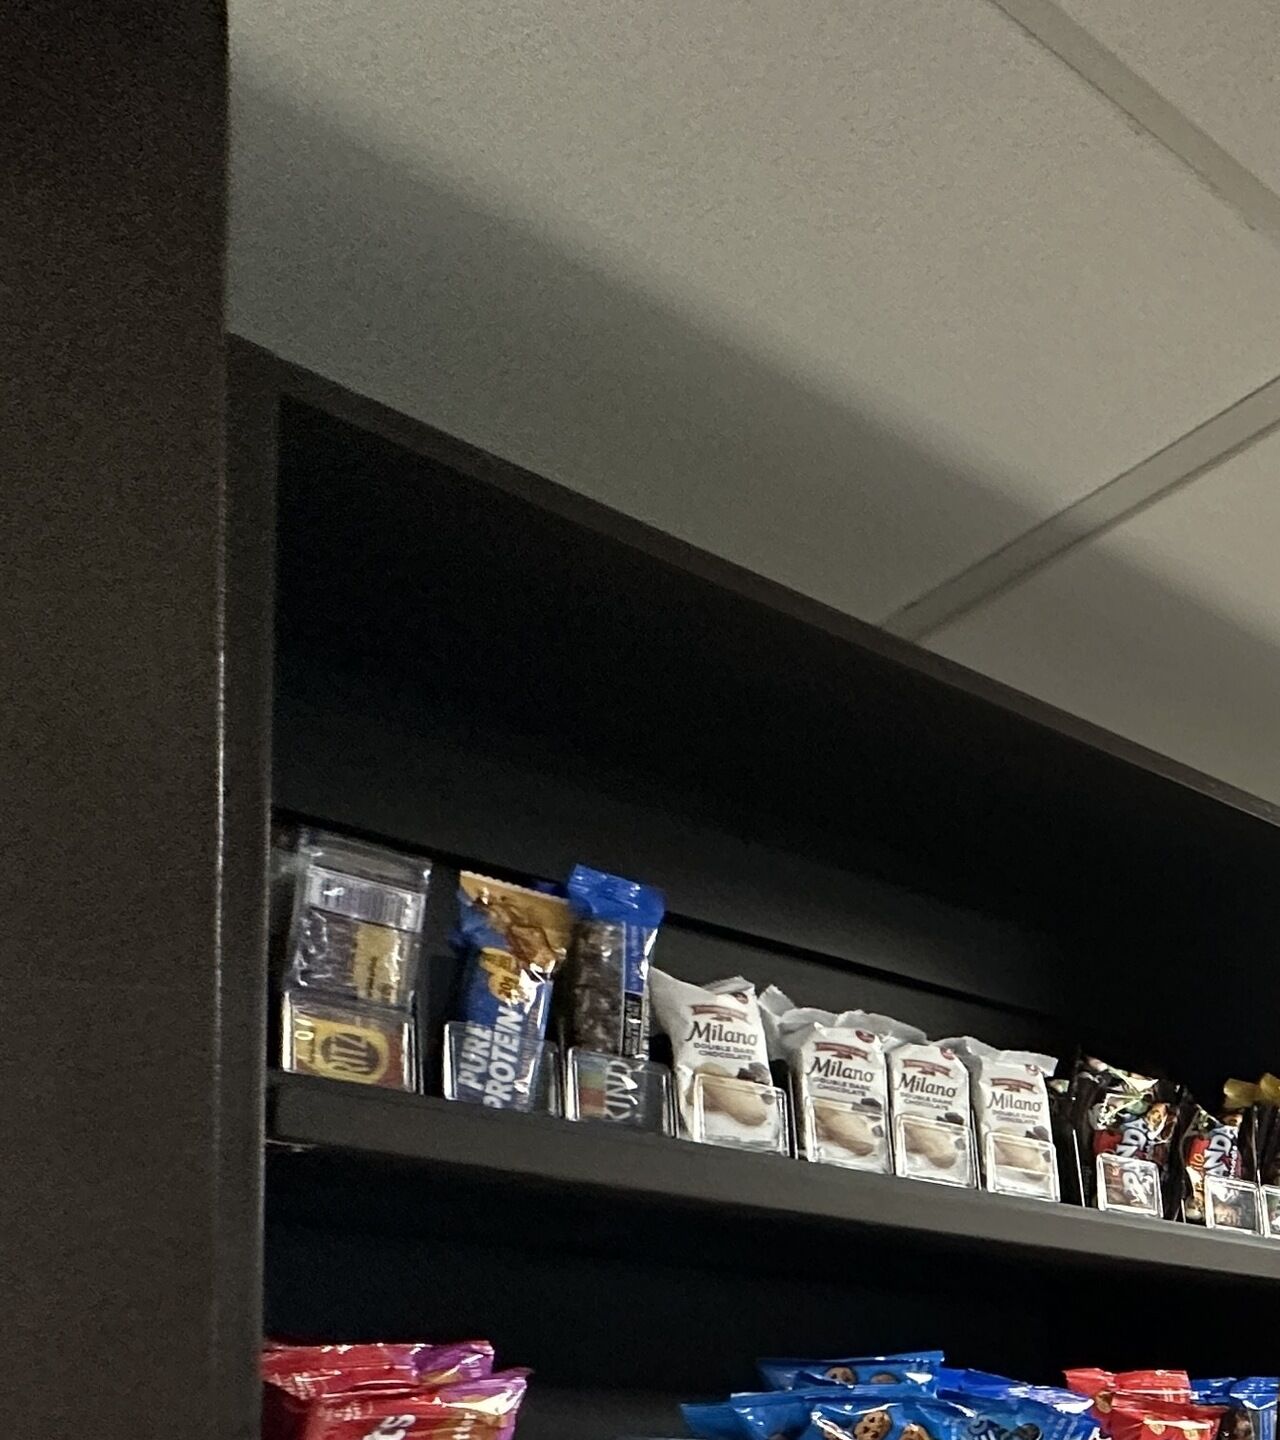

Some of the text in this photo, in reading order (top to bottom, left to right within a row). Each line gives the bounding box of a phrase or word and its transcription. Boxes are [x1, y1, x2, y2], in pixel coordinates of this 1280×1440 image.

[684, 1021, 758, 1046] Milano
[329, 1034, 370, 1073] RITZ
[458, 1020, 492, 1090] PURE
[483, 1006, 524, 1109] PROTEIN
[806, 1056, 874, 1083] Milano
[605, 1060, 634, 1120] KIND
[897, 1073, 957, 1098] Milano
[986, 1092, 1042, 1113] Milano
